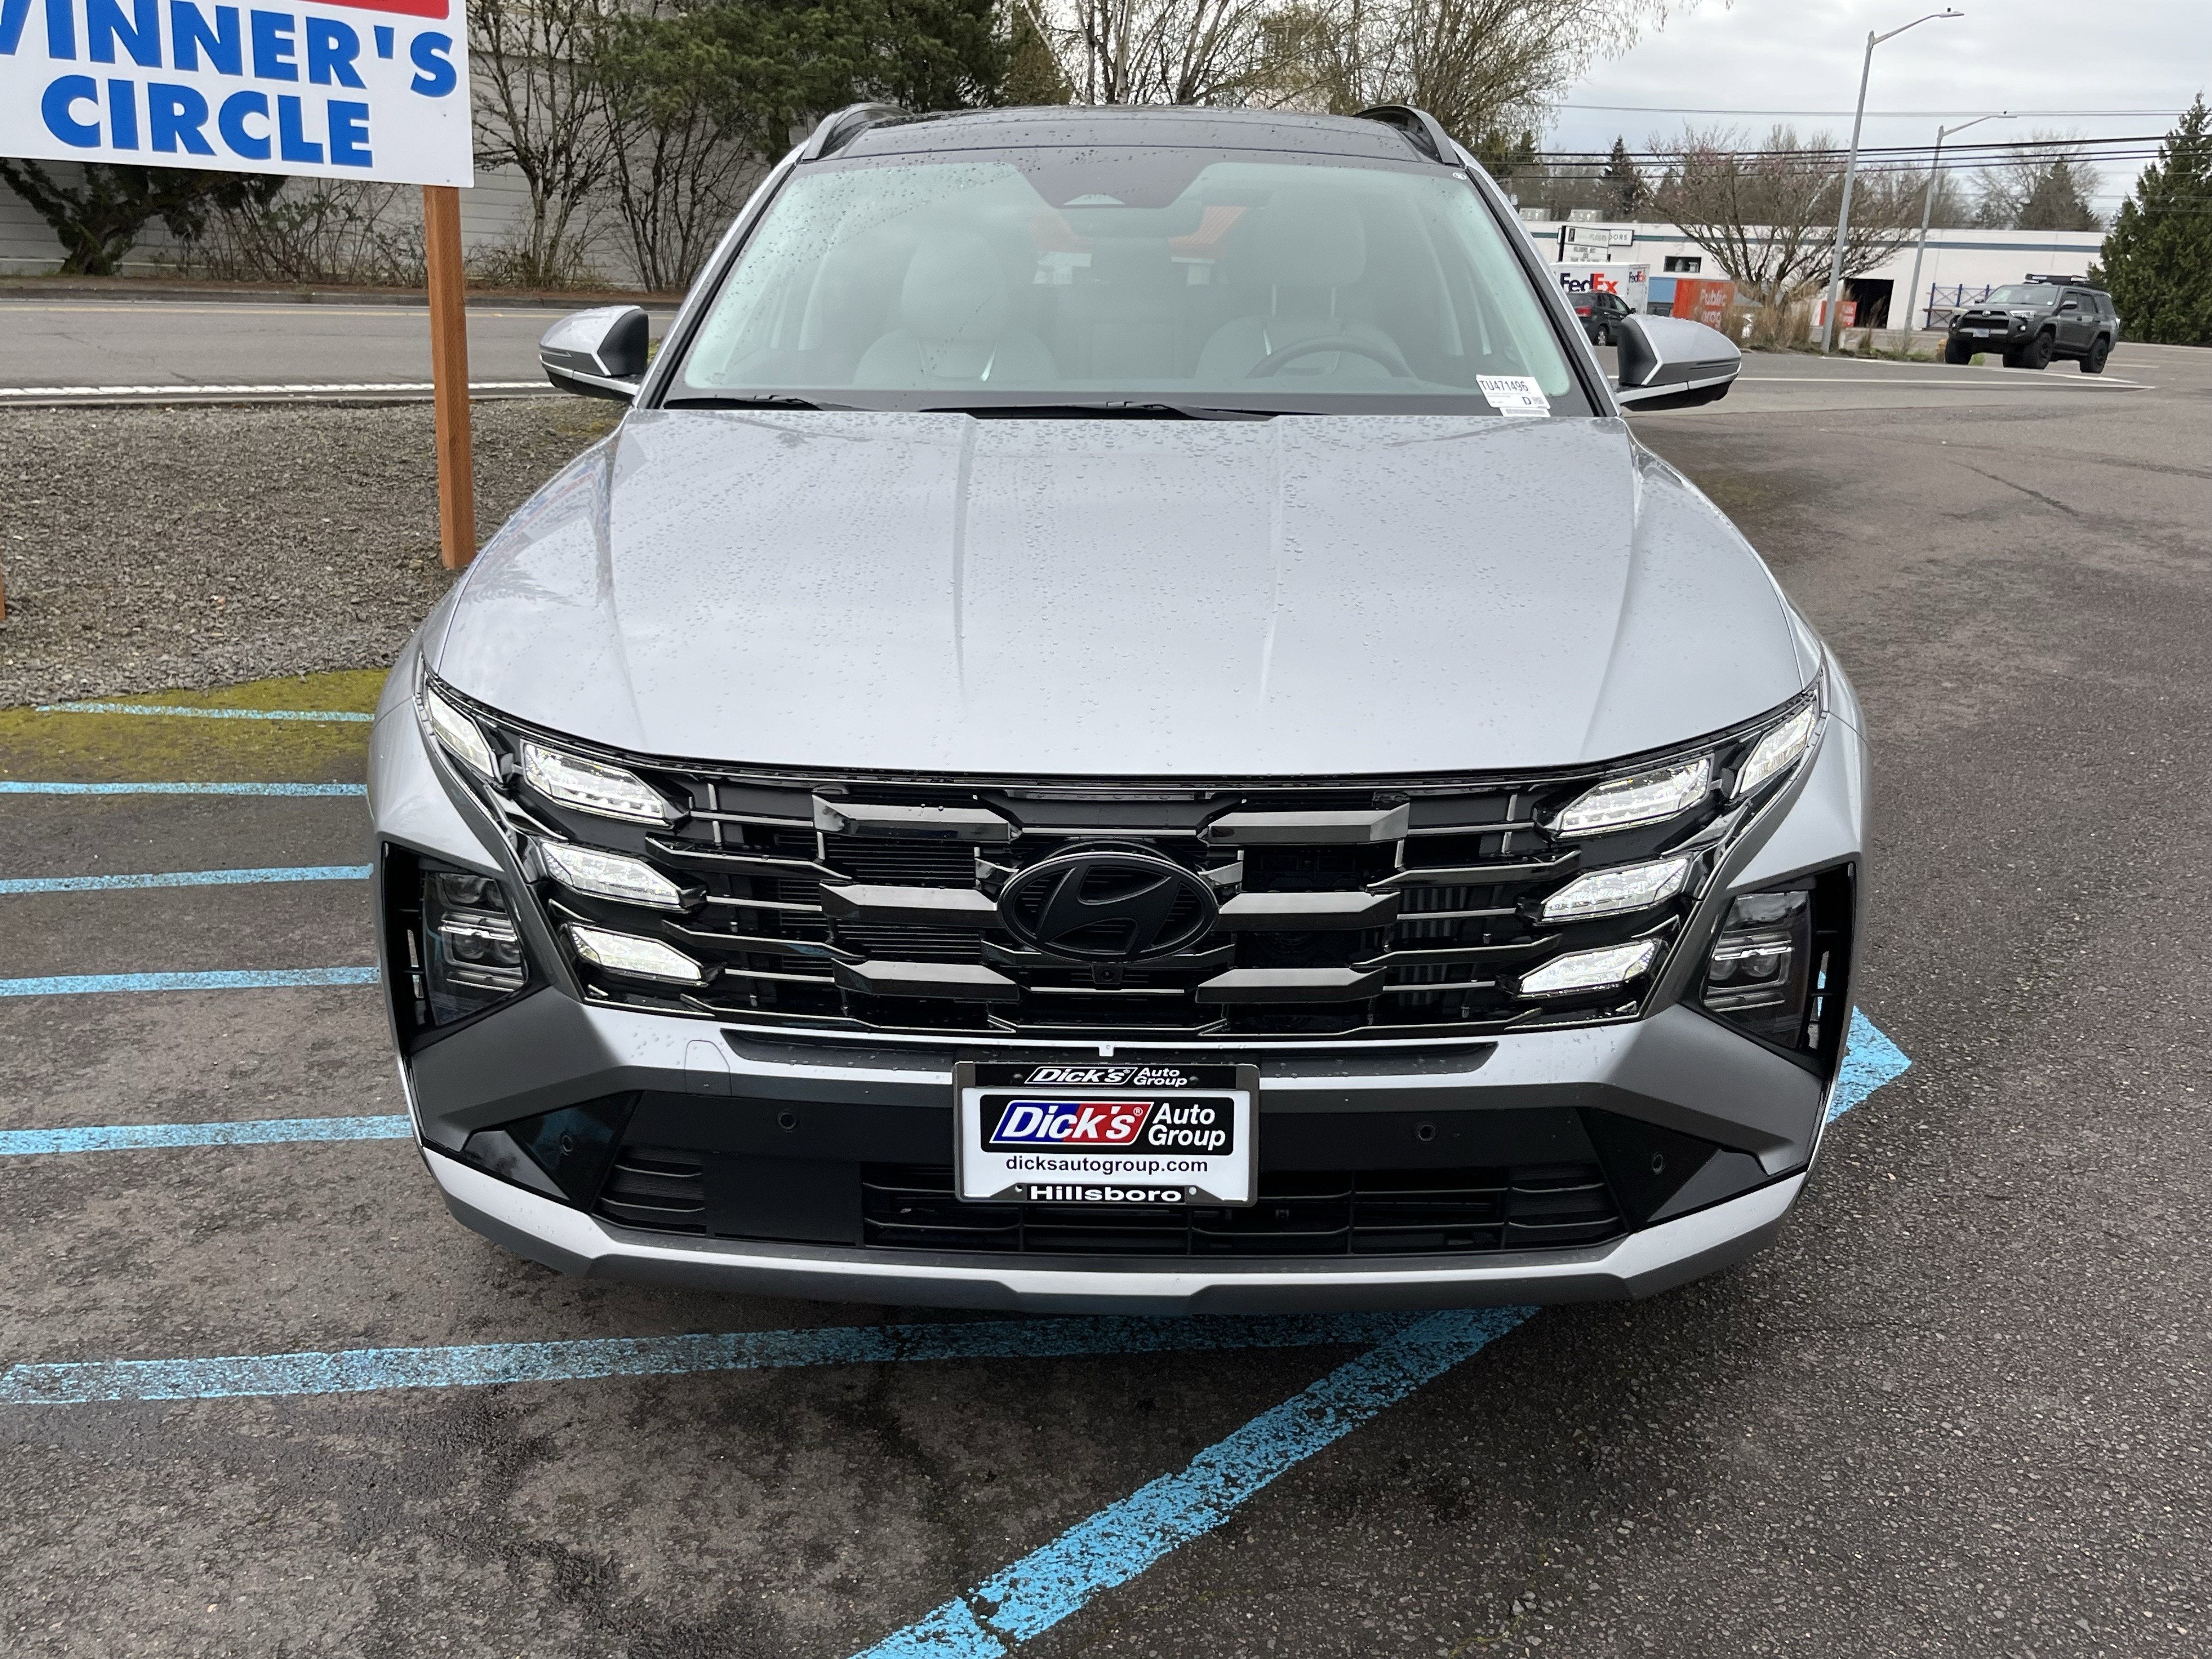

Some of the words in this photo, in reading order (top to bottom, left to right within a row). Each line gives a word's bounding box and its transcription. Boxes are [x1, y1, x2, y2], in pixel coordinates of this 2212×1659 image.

[41, 75, 374, 168] CIRCLE
[1560, 272, 1619, 295] FedEx
[1479, 380, 1529, 392] TU471496
[1032, 1068, 1125, 1082] Dick's
[1137, 1067, 1180, 1077] Auto
[1133, 1077, 1188, 1087] Group
[1001, 1104, 1135, 1140] Dick's
[1154, 1103, 1215, 1125] Auto
[1148, 1125, 1226, 1151] Group
[1006, 1155, 1208, 1175] dicksautogroup.com
[1030, 1186, 1182, 1202] Hillsboro
